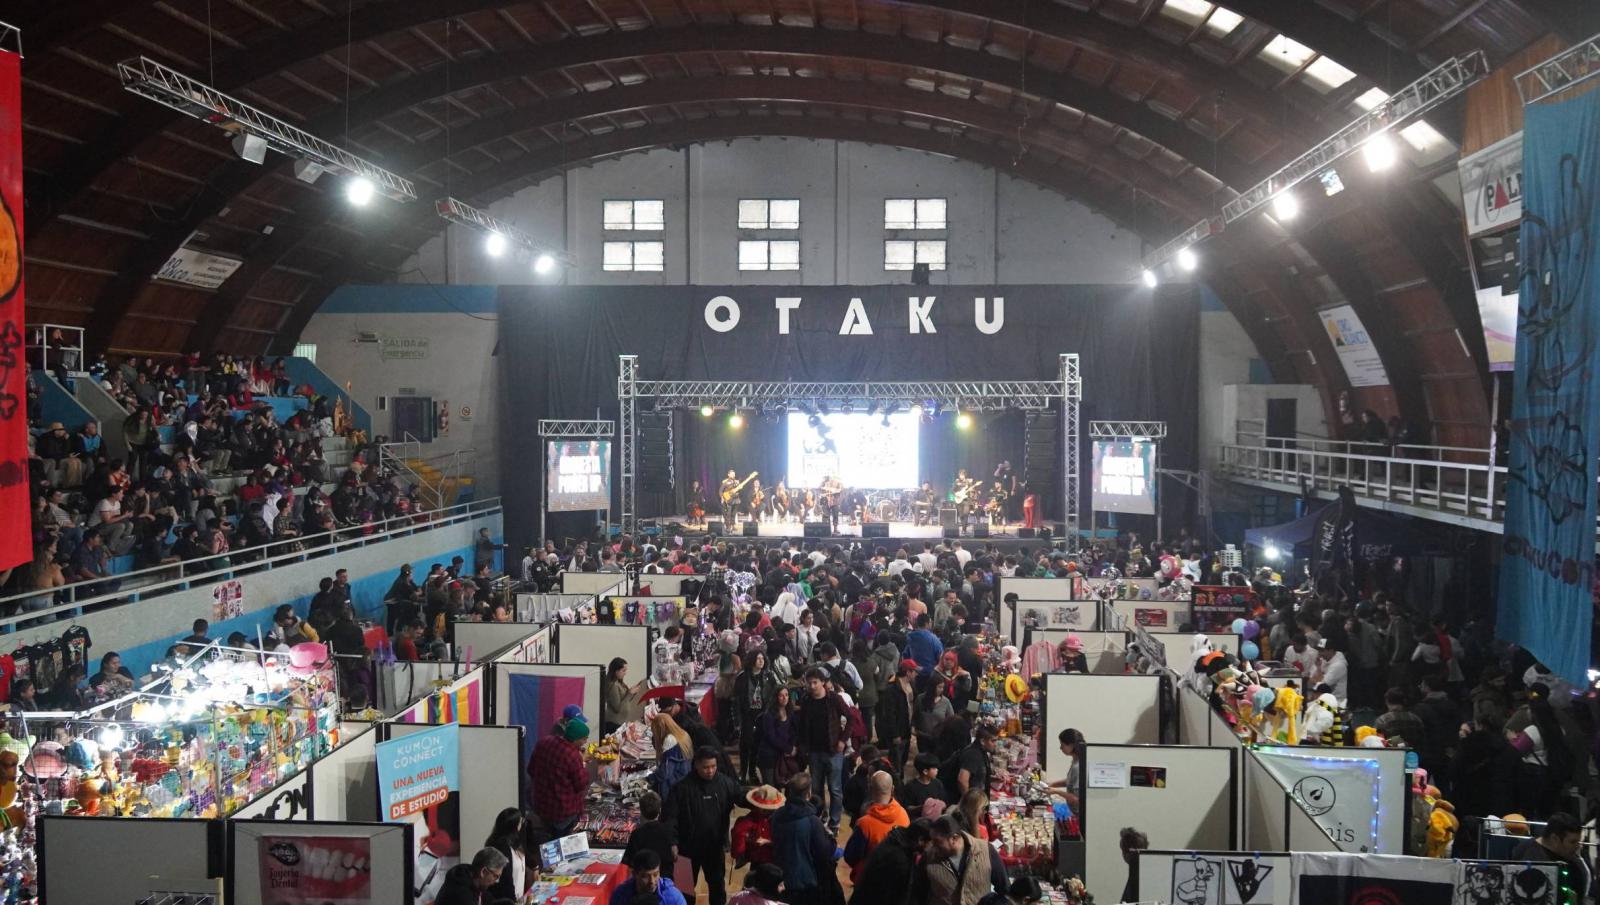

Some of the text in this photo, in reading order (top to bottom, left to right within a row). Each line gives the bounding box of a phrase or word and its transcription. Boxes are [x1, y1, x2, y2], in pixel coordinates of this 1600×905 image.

[704, 295, 1004, 335] OTAKU
[393, 745, 444, 769] CONNECT
[397, 735, 440, 755] KUMON
[390, 776, 448, 803] EXPERIENCIA
[393, 765, 445, 790] UNA NUEVA
[392, 788, 447, 817] DE ESTUDIO
